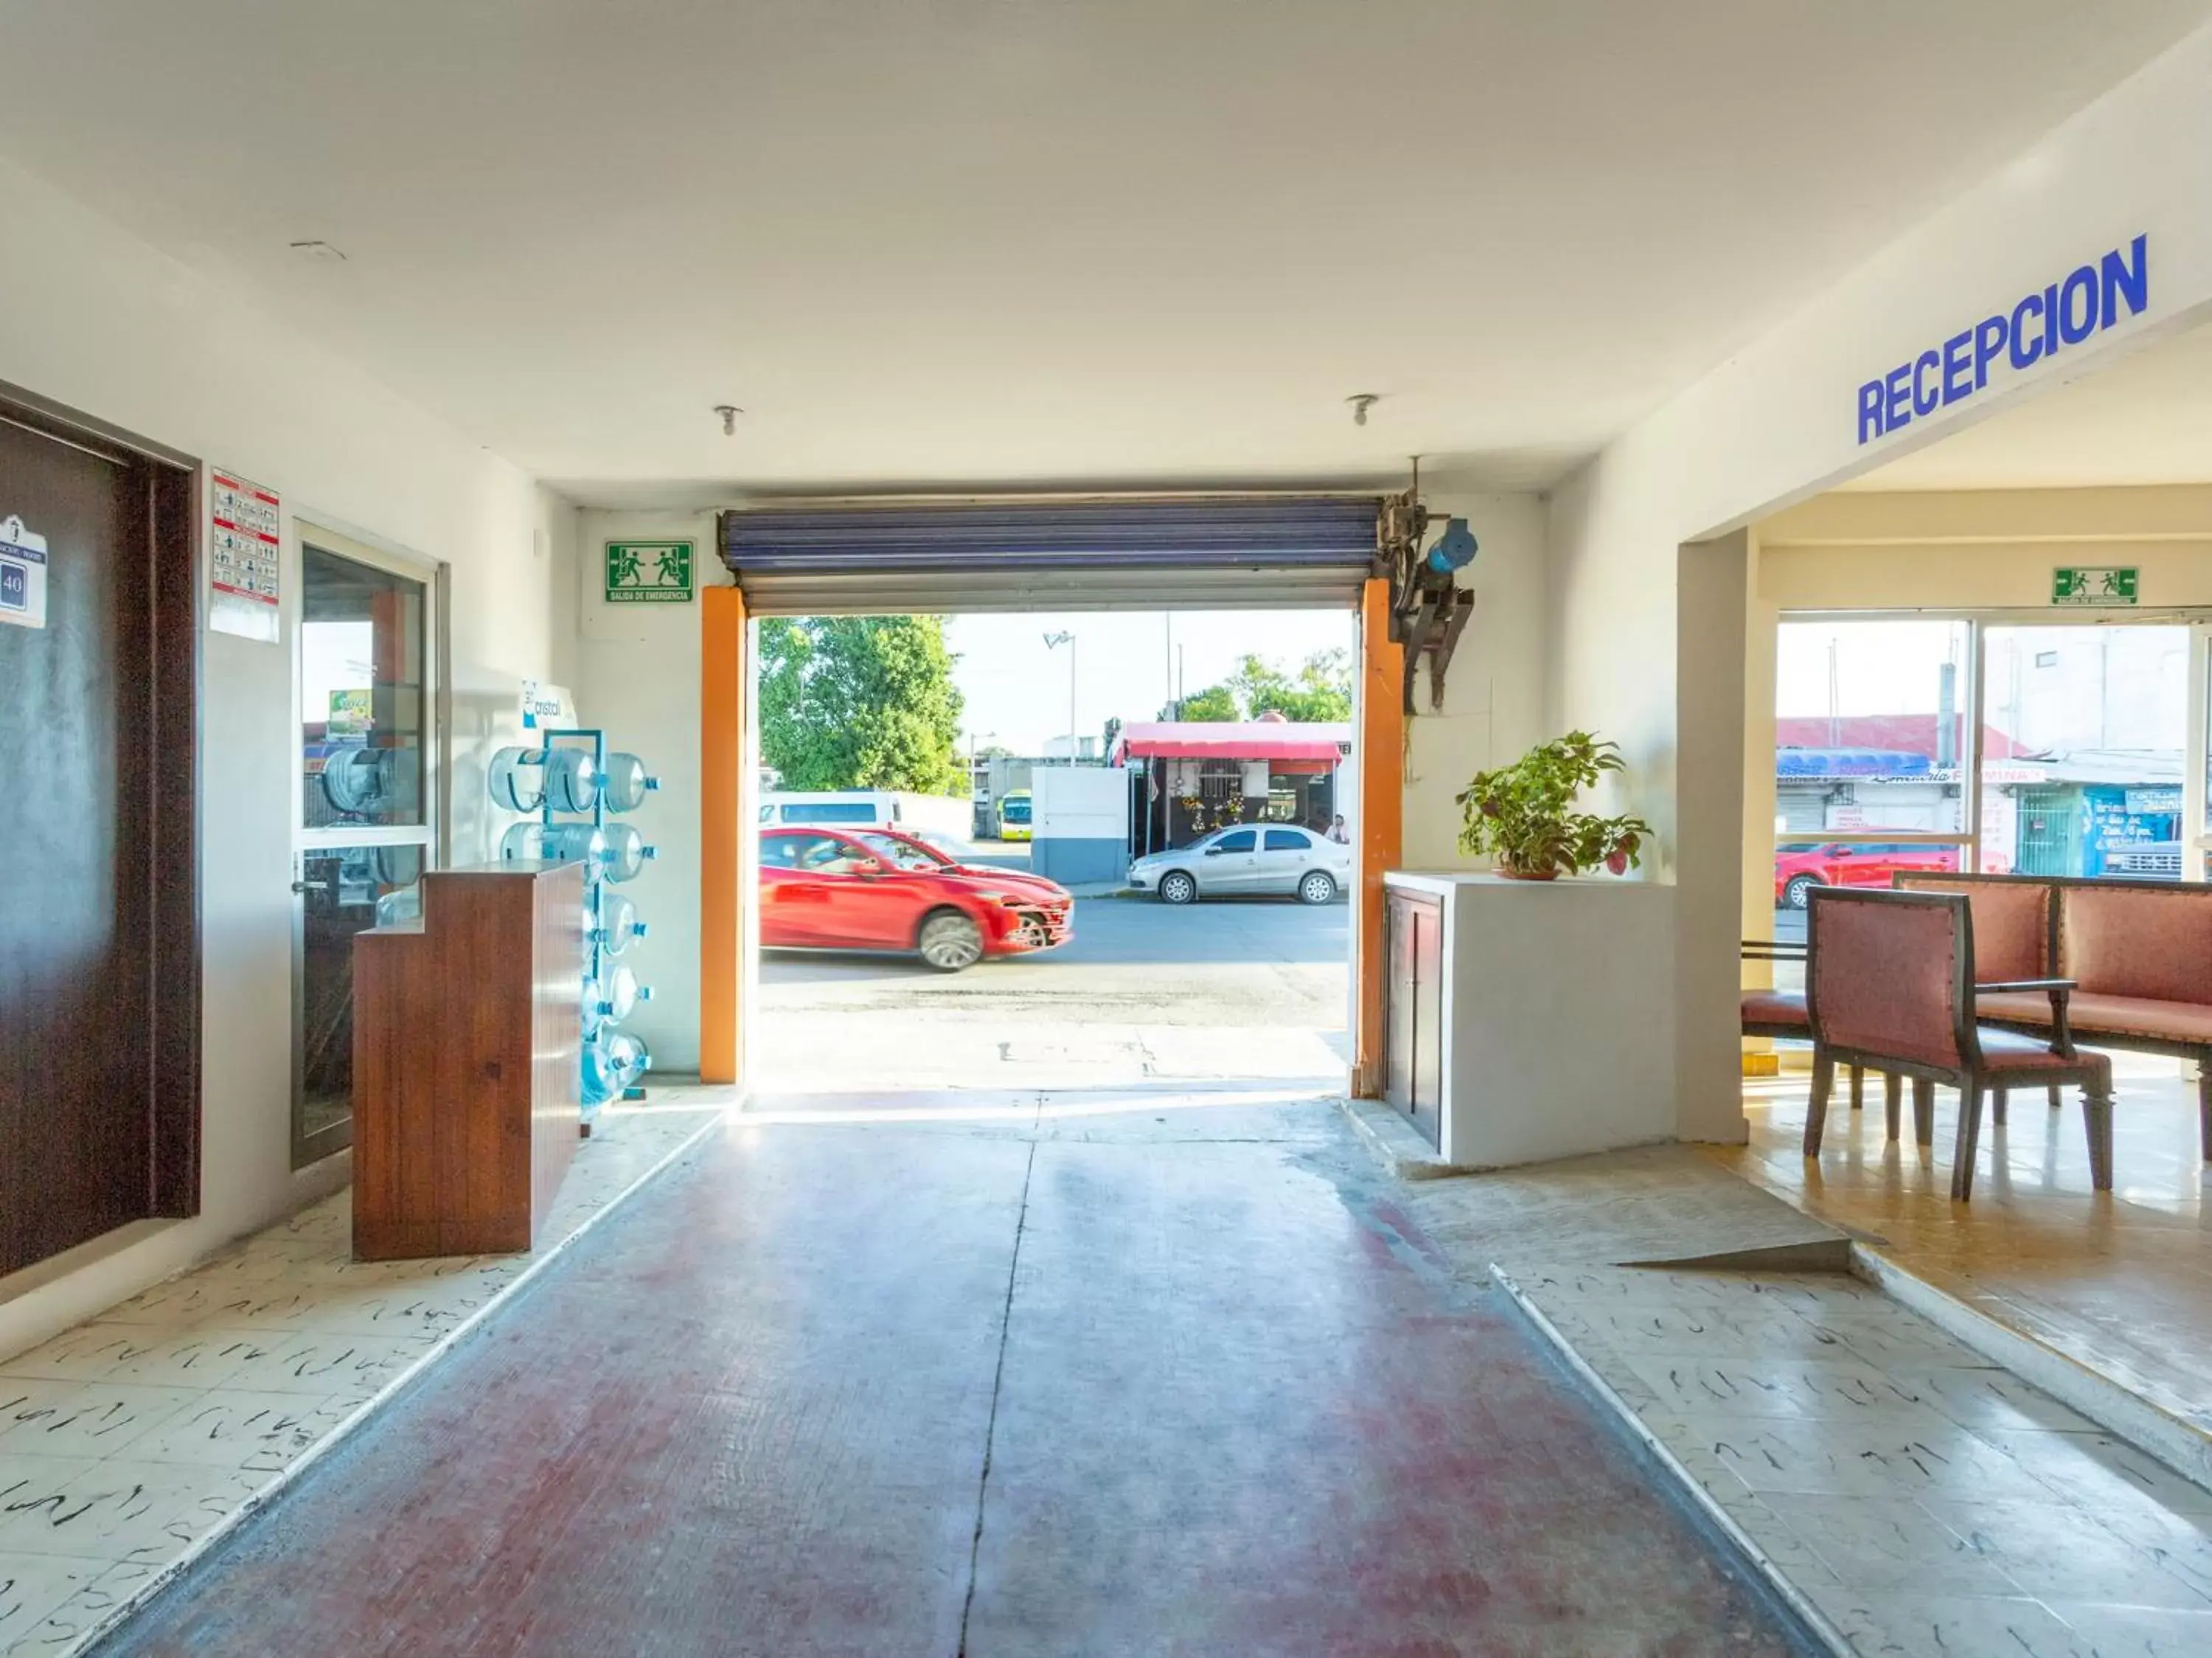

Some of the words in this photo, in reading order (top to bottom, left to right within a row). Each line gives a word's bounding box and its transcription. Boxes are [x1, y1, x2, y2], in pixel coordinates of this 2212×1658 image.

[1858, 233, 2147, 445] RECEPCION
[3, 574, 22, 592] 40
[611, 592, 633, 601] SALIDA
[635, 592, 644, 601] DE
[646, 592, 688, 601] EMERGENCIA
